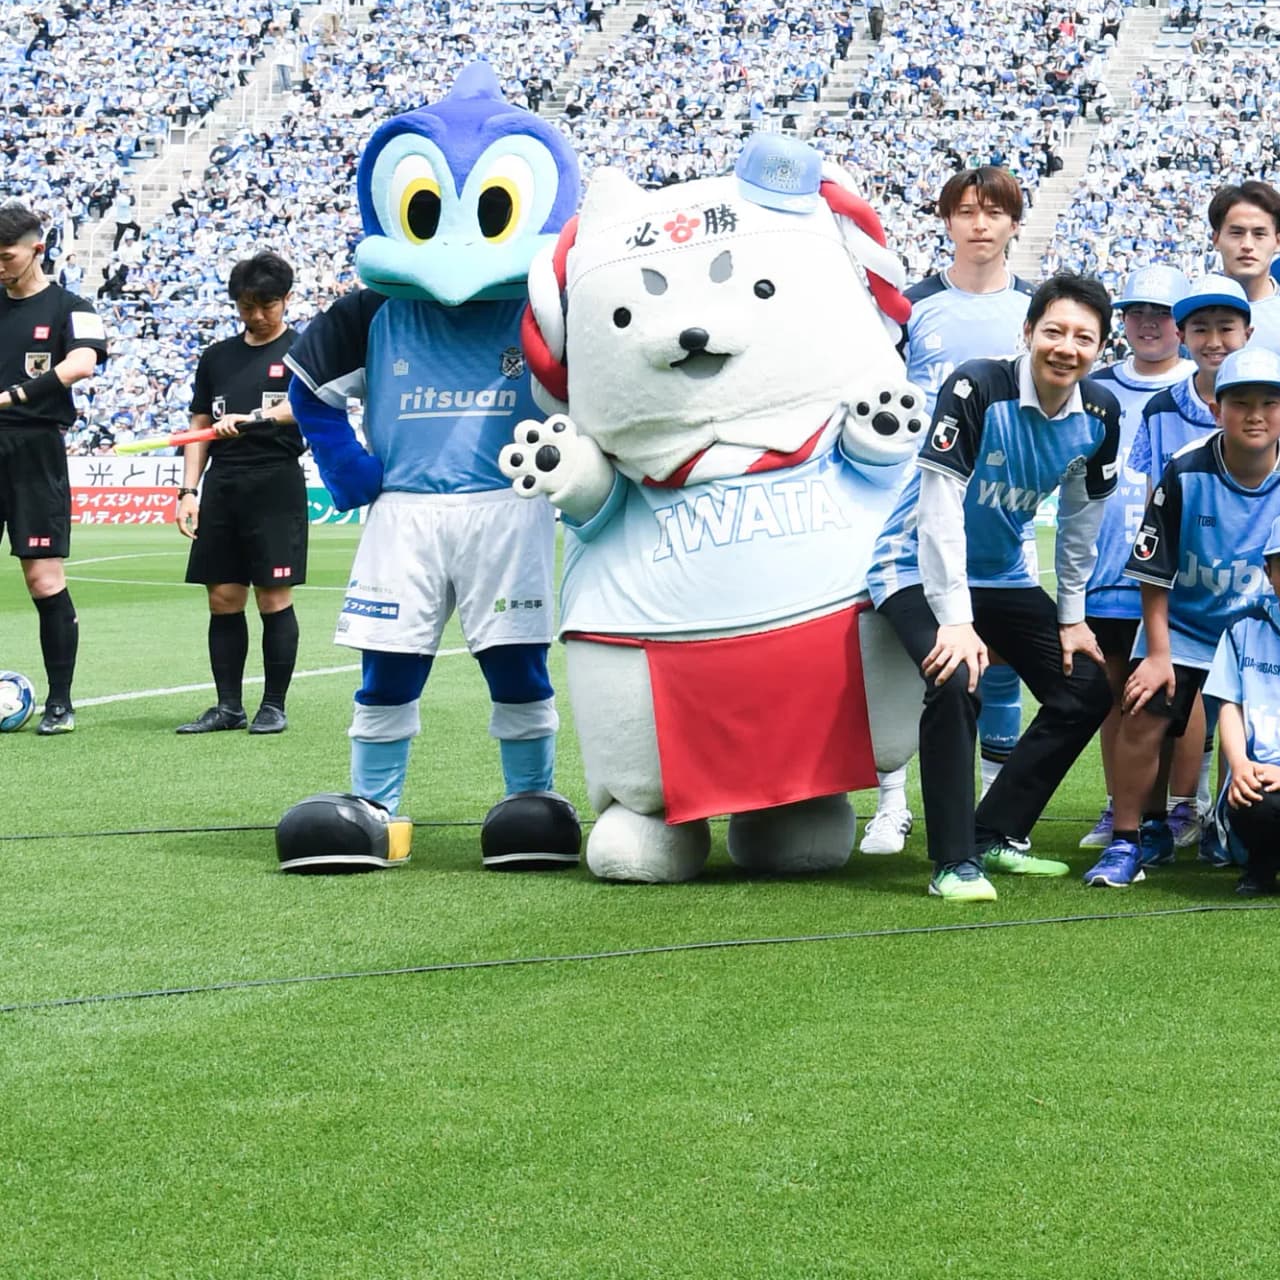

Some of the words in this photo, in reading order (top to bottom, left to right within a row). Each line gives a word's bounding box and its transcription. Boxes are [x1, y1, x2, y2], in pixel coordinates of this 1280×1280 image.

[627, 221, 660, 251] 必
[704, 203, 739, 237] 勝
[400, 386, 517, 410] ritsuan
[71, 493, 174, 507] ライズジャパン
[653, 478, 852, 562] IWATA
